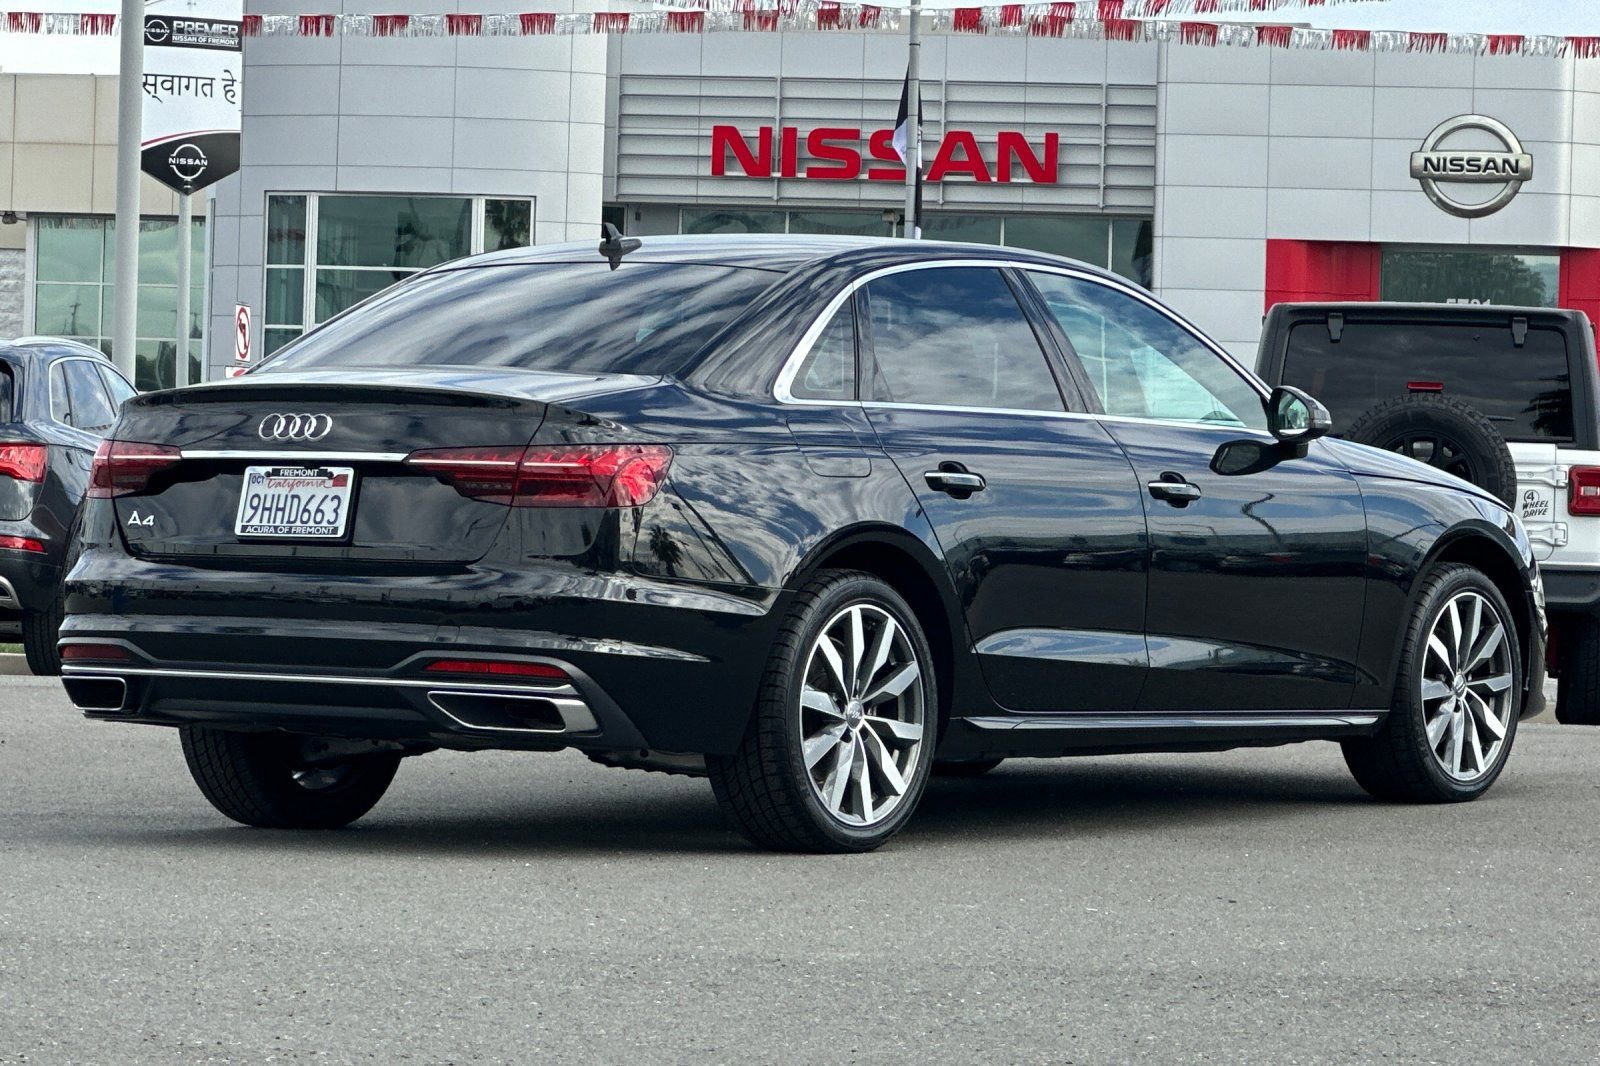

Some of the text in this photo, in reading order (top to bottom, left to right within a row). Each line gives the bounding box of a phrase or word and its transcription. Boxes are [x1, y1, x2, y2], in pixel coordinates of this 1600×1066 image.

[172, 20, 239, 38] PREMIER
[172, 35, 197, 43] NISSAN
[208, 37, 239, 46] FREMONT
[711, 125, 1059, 183] NISSAN
[168, 157, 208, 166] NISSAN
[1423, 156, 1520, 175] NISSAN
[280, 468, 318, 477] FREMONT
[267, 479, 328, 493] California
[246, 493, 342, 525] 9HHD663
[1522, 500, 1549, 510] WHEEL
[128, 511, 155, 527] A4
[1523, 508, 1548, 518] DRIVE
[245, 526, 334, 535] ACURA OF FREMONT
